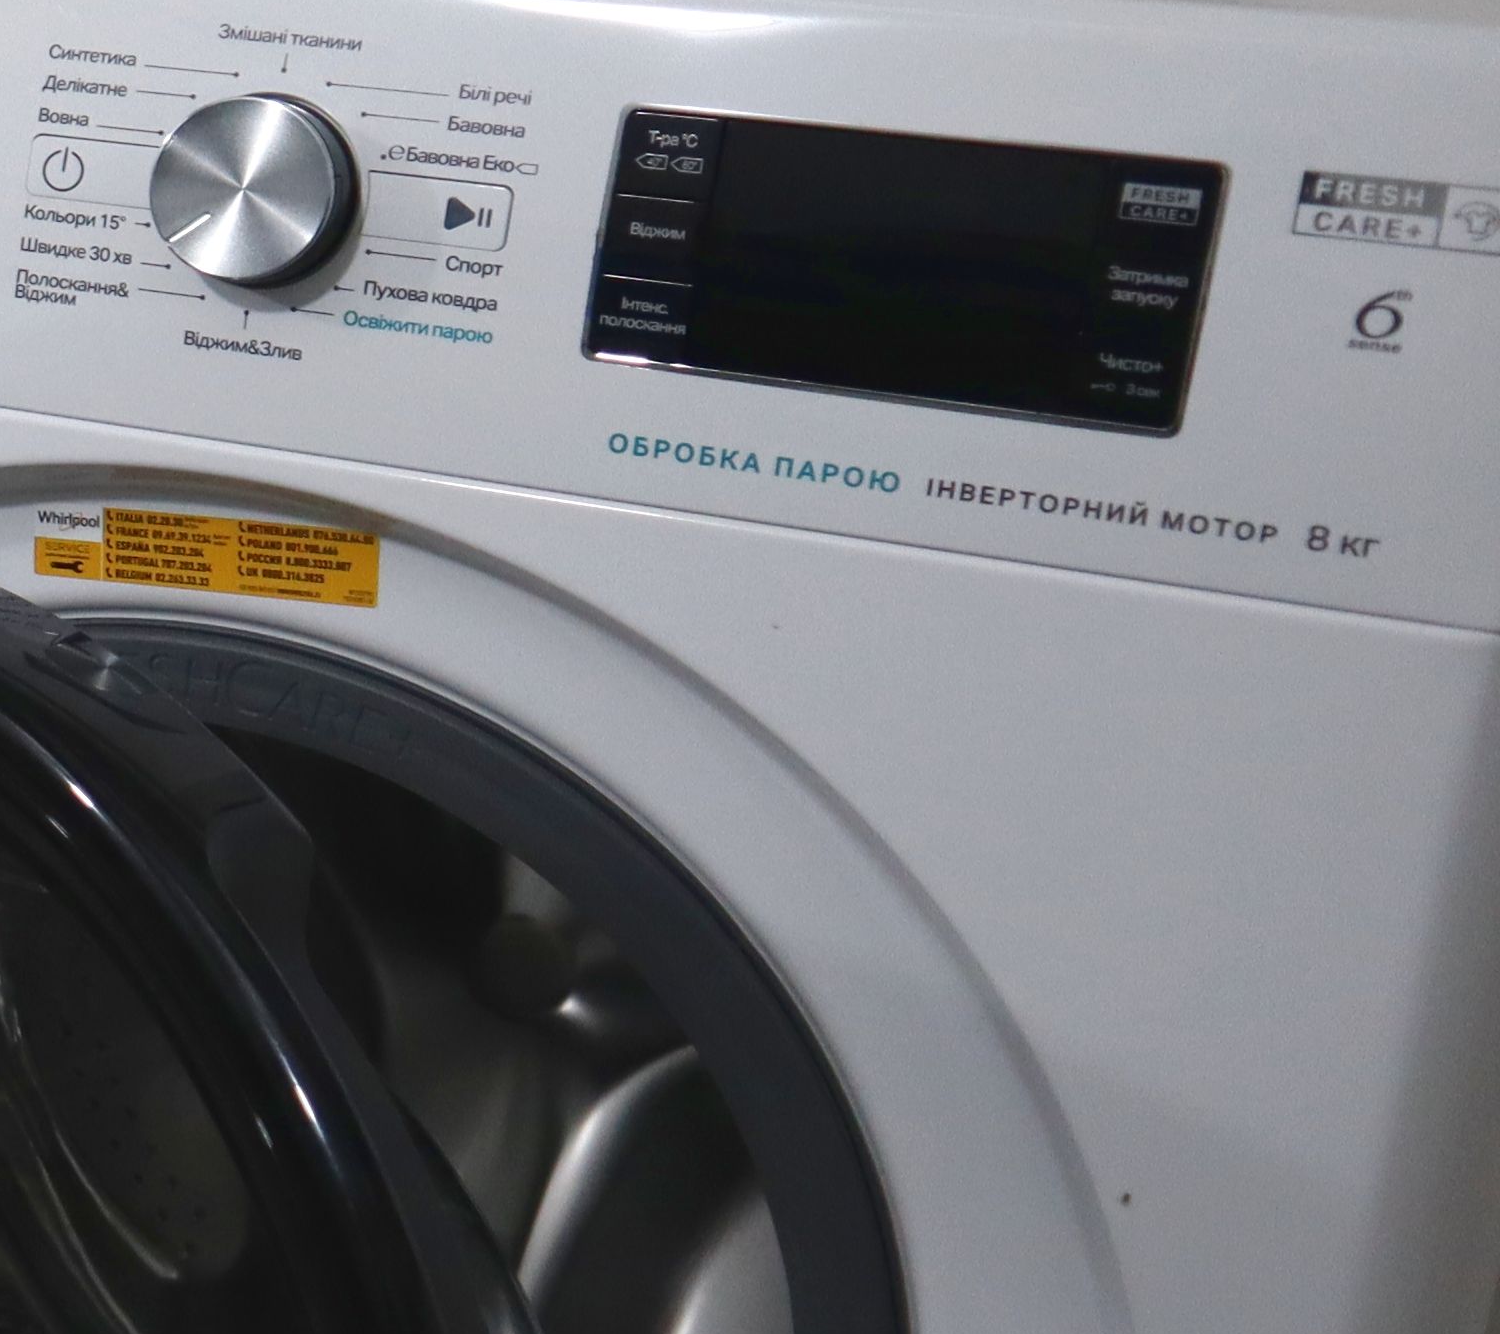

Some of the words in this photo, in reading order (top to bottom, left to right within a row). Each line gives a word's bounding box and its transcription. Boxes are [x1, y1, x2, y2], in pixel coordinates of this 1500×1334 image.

[217, 23, 289, 47] Змішані
[291, 29, 363, 53] тканини
[48, 44, 138, 68] Синтетика
[42, 75, 128, 99] Делікатне
[458, 83, 491, 103] Білі
[492, 88, 533, 108] речі
[38, 107, 90, 128] Вовна
[447, 115, 526, 139] Бавовна
[406, 145, 480, 170] Бавовна
[481, 155, 515, 174] Еко
[1130, 186, 1191, 205] FRESH
[1314, 177, 1426, 209] FRESH
[24, 203, 97, 231] Кольори
[100, 211, 127, 232] 15°
[1130, 204, 1189, 222] CARE+
[1312, 210, 1423, 241] CARE+
[629, 221, 687, 241] Віджим
[19, 237, 86, 263] Швидке
[89, 245, 111, 262] 30
[113, 250, 133, 265] хв
[445, 254, 504, 279] Спорт
[1107, 264, 1190, 289] Затримка
[15, 268, 130, 298] Полоскання&
[14, 285, 78, 309] Віджим
[363, 280, 430, 307] Пухова
[431, 291, 499, 314] ковдра
[621, 295, 670, 315] Інтенс.
[598, 313, 688, 336] полоскання
[1354, 290, 1404, 339] 6
[342, 310, 430, 340] Освіжити
[432, 323, 495, 345] парою
[183, 330, 304, 362] Віджим&Злив
[607, 431, 762, 475] ОБРОБКА
[774, 455, 902, 495] ПАРОЮ
[925, 477, 1150, 528] ІНВЕРТОРНИЙ
[1160, 509, 1280, 545] МОТОР
[1305, 524, 1332, 553] 8
[37, 509, 101, 532] Whirlpool
[115, 527, 150, 539] FRANCE
[45, 541, 91, 555] SERVICE
